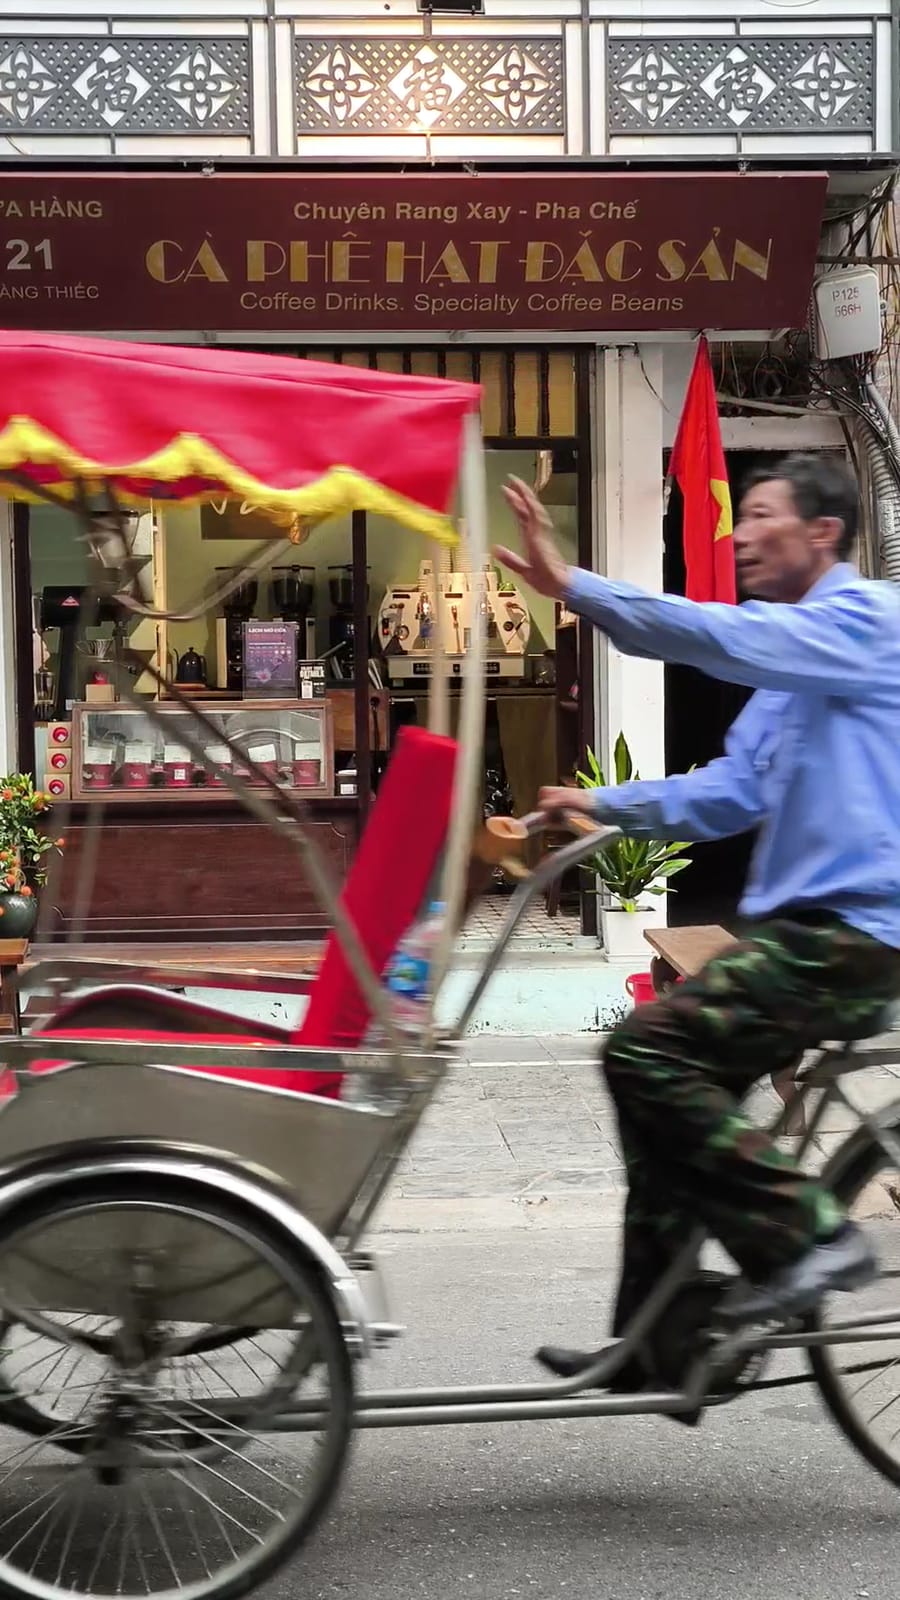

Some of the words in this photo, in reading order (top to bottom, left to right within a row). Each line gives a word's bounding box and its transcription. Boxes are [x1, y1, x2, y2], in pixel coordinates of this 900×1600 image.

[0, 200, 23, 218] A
[30, 195, 103, 218] HÀNG
[293, 201, 386, 224] Chuyên
[395, 202, 458, 224] Rang
[466, 202, 512, 224] Xay
[535, 202, 581, 220] Pha
[589, 199, 640, 219] Chế
[5, 239, 54, 271] 21
[145, 231, 230, 284] CÀ
[246, 231, 372, 284] PHÊ
[386, 239, 511, 287] HẠT
[518, 229, 644, 286] ĐẶC
[655, 226, 773, 283] SẢN
[240, 291, 317, 311] Coffee
[413, 293, 520, 315] Specialty
[527, 293, 602, 312] Coffee
[610, 293, 684, 311] Beans
